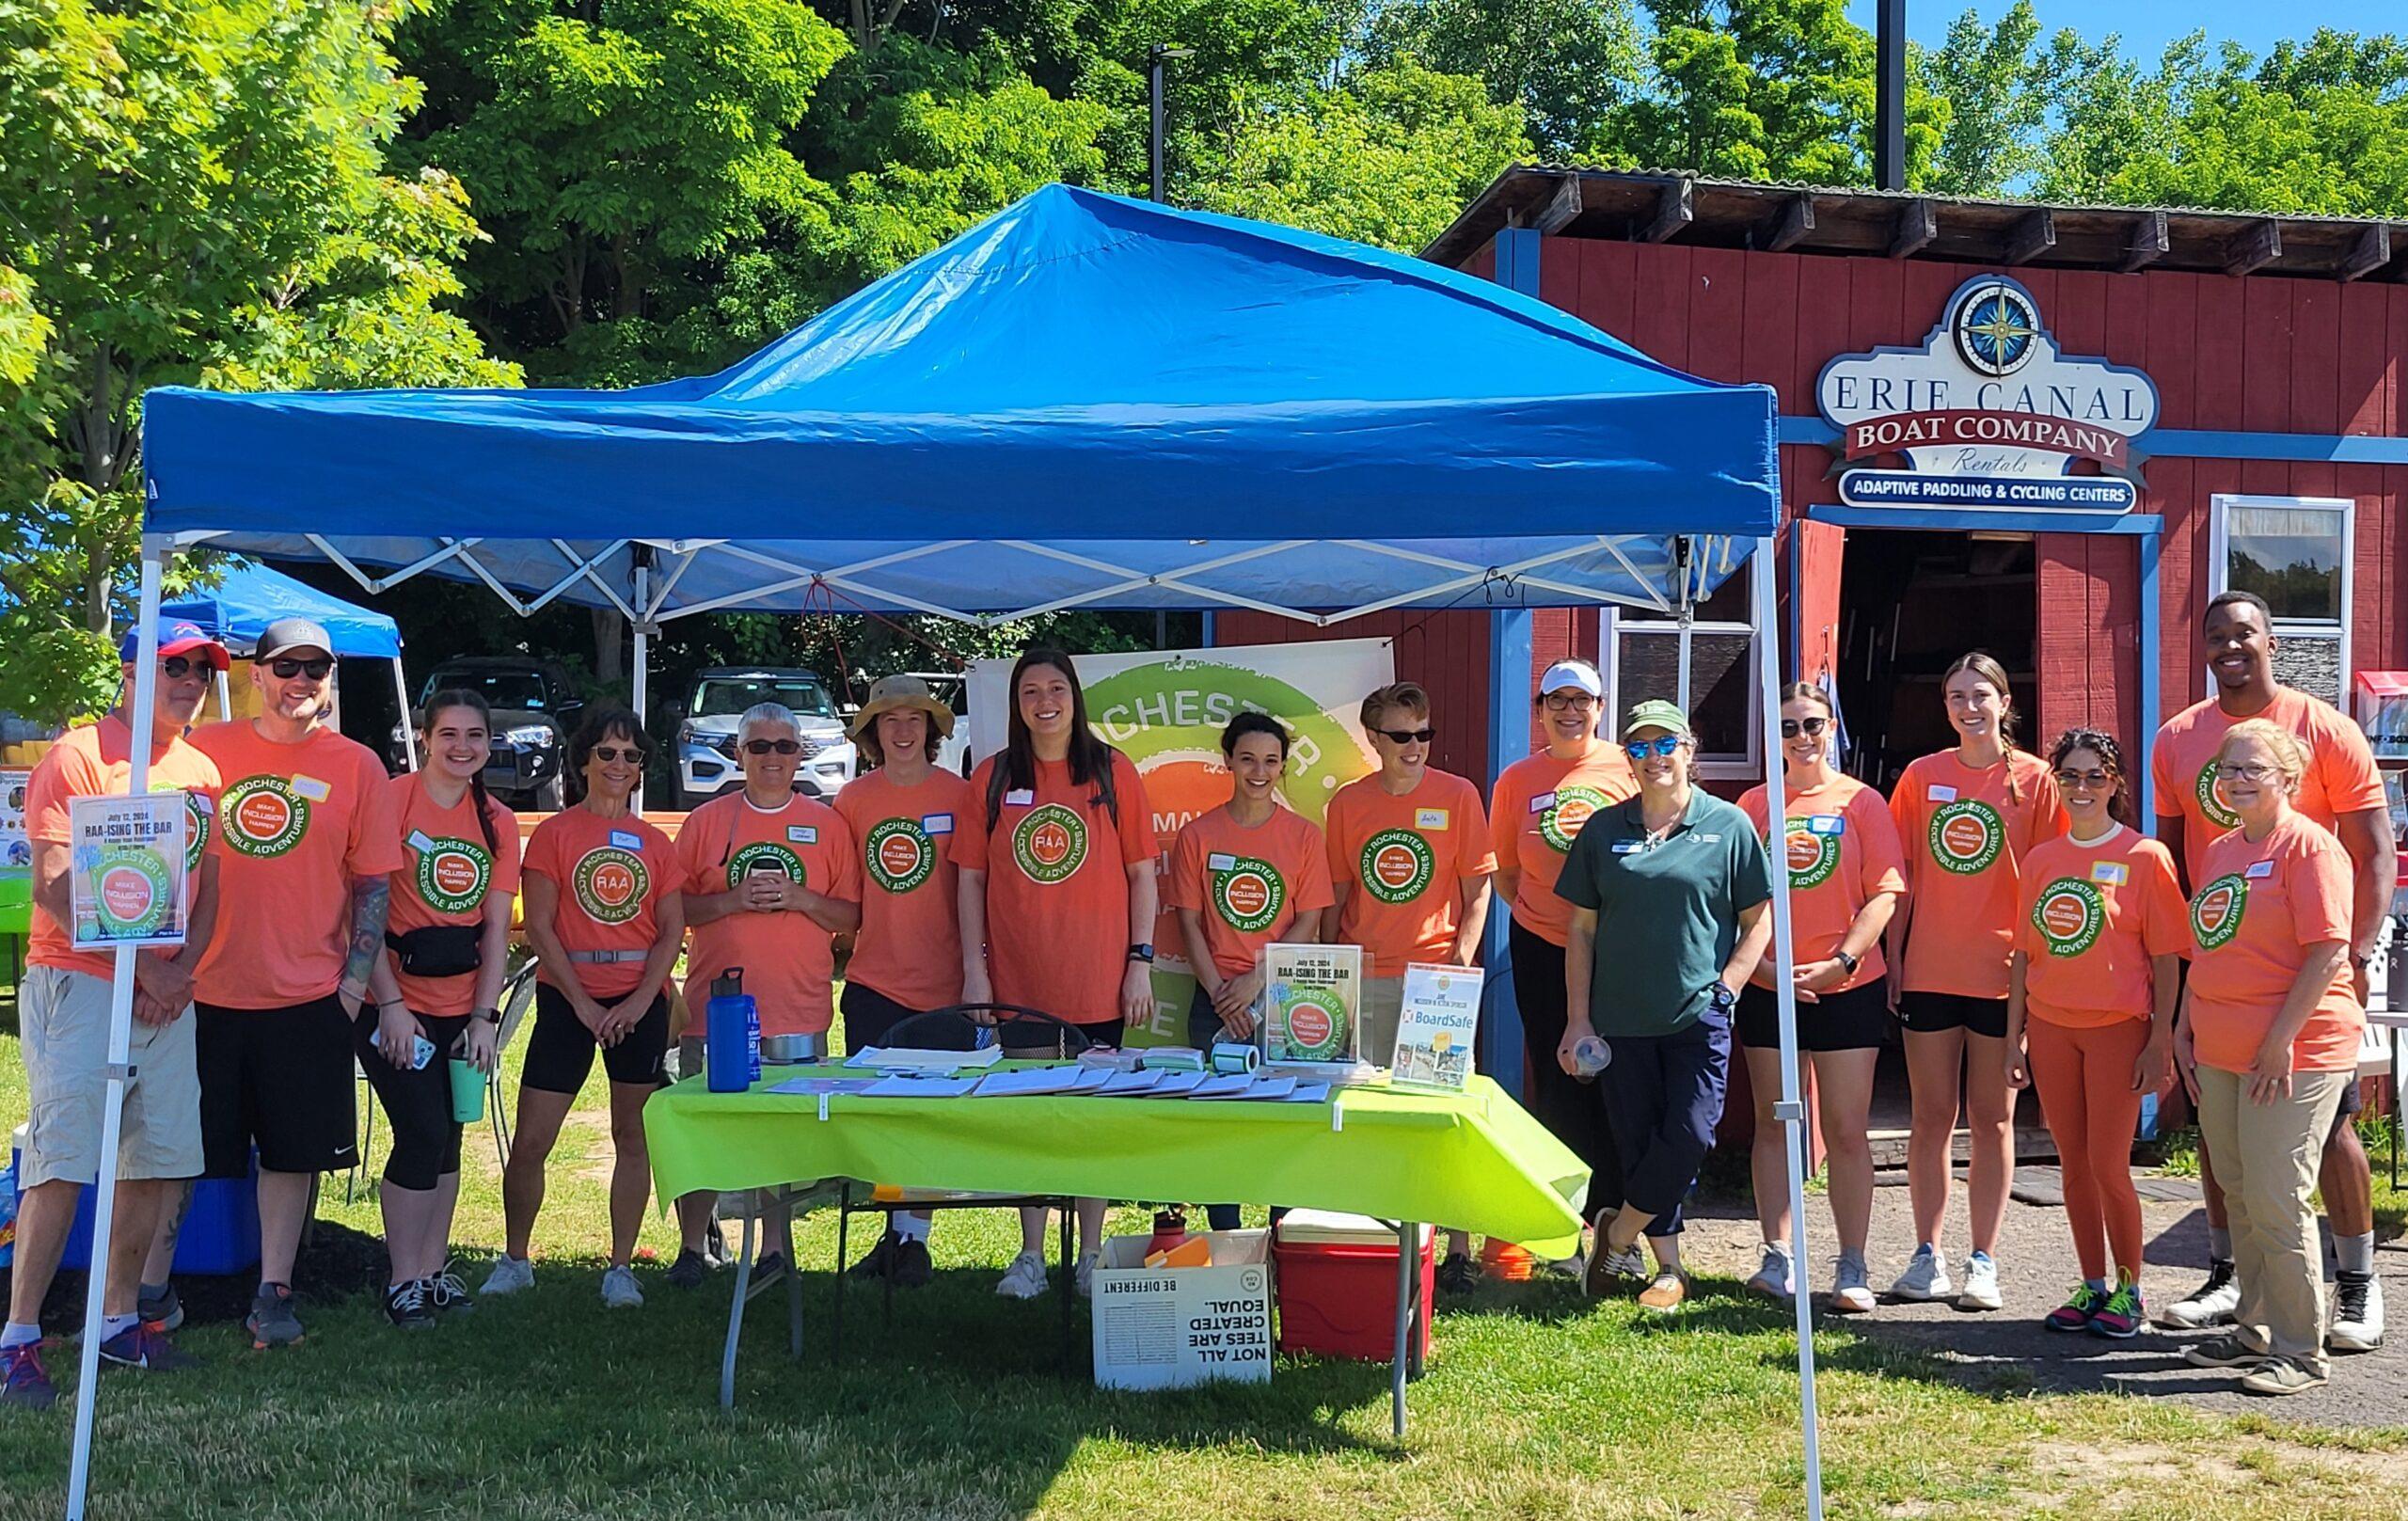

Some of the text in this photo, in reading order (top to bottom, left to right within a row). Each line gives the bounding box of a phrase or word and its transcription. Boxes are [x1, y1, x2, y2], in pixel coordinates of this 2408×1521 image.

[1833, 376, 2144, 421] ERIE CANAL
[1857, 417, 2118, 457] BOAT COMPANY
[1952, 447, 2028, 473] Rentals
[1853, 480, 2125, 502] ADAPTIVE PADDLING & CYCLING CENTERS
[2198, 776, 2230, 825] ACCESSIBLE
[107, 814, 120, 822] July
[133, 812, 149, 821] 2024
[243, 809, 285, 822] INCLUSION
[1025, 809, 1077, 828] ROCHESTER
[1940, 802, 1995, 824] ROCHESTER
[85, 822, 132, 837] RAA-ISING
[134, 823, 150, 834] THE
[153, 821, 172, 834] BAR
[222, 796, 251, 851] ACCESSIBLE
[253, 808, 305, 853] ADVENTURES
[873, 822, 927, 842] ROCHESTER
[1035, 835, 1065, 848] RAA
[1370, 832, 1424, 851] ROCHESTER
[1930, 819, 2000, 871] ACCESSIBLE ADVENTURES
[584, 851, 640, 870] ROCHESTER
[739, 846, 796, 864] ROCHESTER
[1045, 830, 1083, 878] ADVENTURES
[1795, 841, 1835, 886] ADVENTURES
[437, 868, 474, 879] INCLUSION
[892, 846, 931, 890] ADVENTURES
[1362, 851, 1430, 901] ACCESSIBLE ADVENTURES
[420, 854, 490, 911] ACCESSIBLE ADVENTURES
[596, 876, 628, 889] RAA
[2045, 881, 2099, 903] ROCHESTER
[1229, 890, 1265, 899] INCLUSION
[121, 876, 167, 937] ADVENTURES
[1243, 885, 1281, 929] ADVENTURES
[2054, 908, 2100, 954] ADVENTURES
[1277, 967, 1350, 979] RAA-ISING THE BAR
[1415, 1011, 1474, 1029] BoardSafe
[1103, 1280, 1177, 1293] BE DIFFERENT
[1204, 1299, 1264, 1314] EQUAL.
[1190, 1316, 1265, 1331] CREATED
[1189, 1332, 1266, 1347] TEES ARE
[1197, 1348, 1266, 1363] NOT ALL
